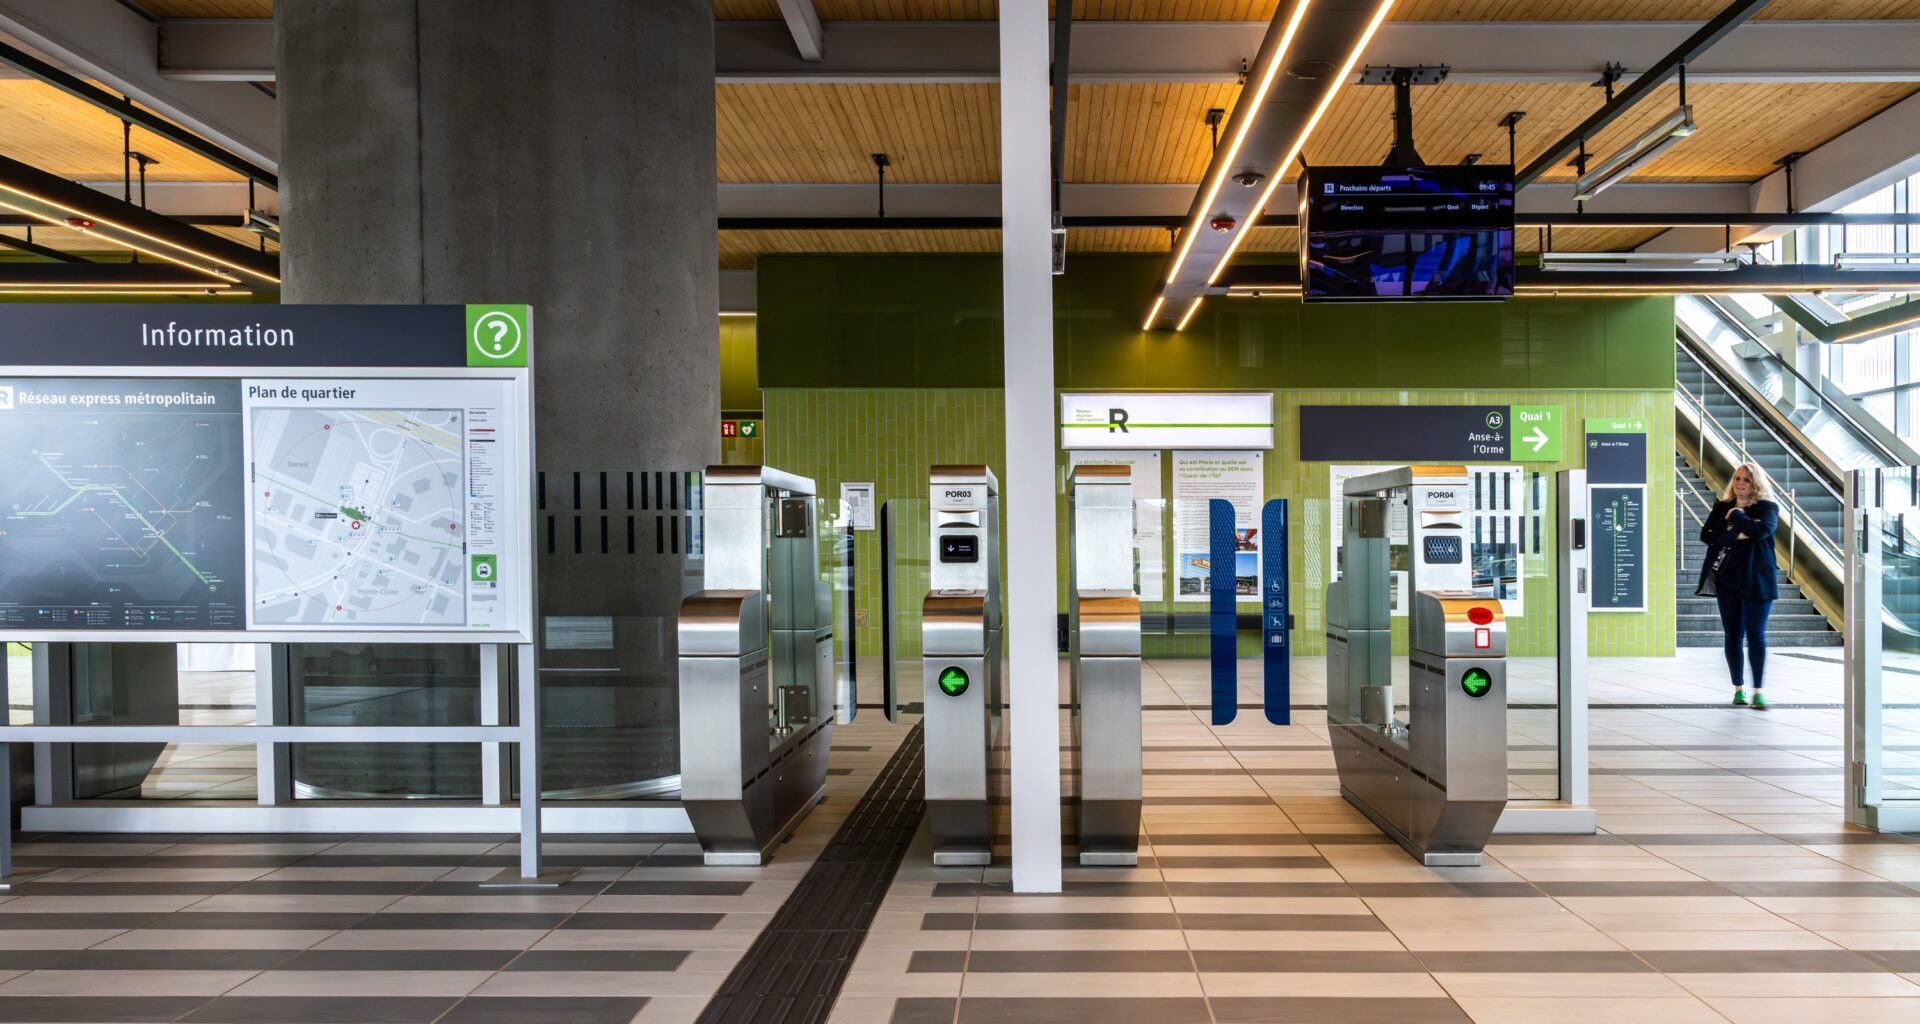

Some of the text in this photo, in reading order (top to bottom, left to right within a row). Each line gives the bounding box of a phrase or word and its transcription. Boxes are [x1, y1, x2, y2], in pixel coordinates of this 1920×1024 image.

[1340, 184, 1391, 193] Prochains départs
[1479, 183, 1496, 191] 09:45
[1471, 203, 1489, 211] Départ
[141, 321, 296, 347] Information
[249, 386, 356, 402] Plan de quartier
[19, 391, 216, 407] Réseau express métropolitain
[1109, 408, 1129, 433] R
[1488, 416, 1501, 425] A3
[1519, 411, 1551, 423] Quai 1
[1611, 422, 1627, 430] Quai
[1468, 432, 1504, 442] Anse-à-
[1473, 444, 1505, 455] l'Orme
[945, 490, 972, 498] POR03
[1428, 491, 1454, 499] POR04
